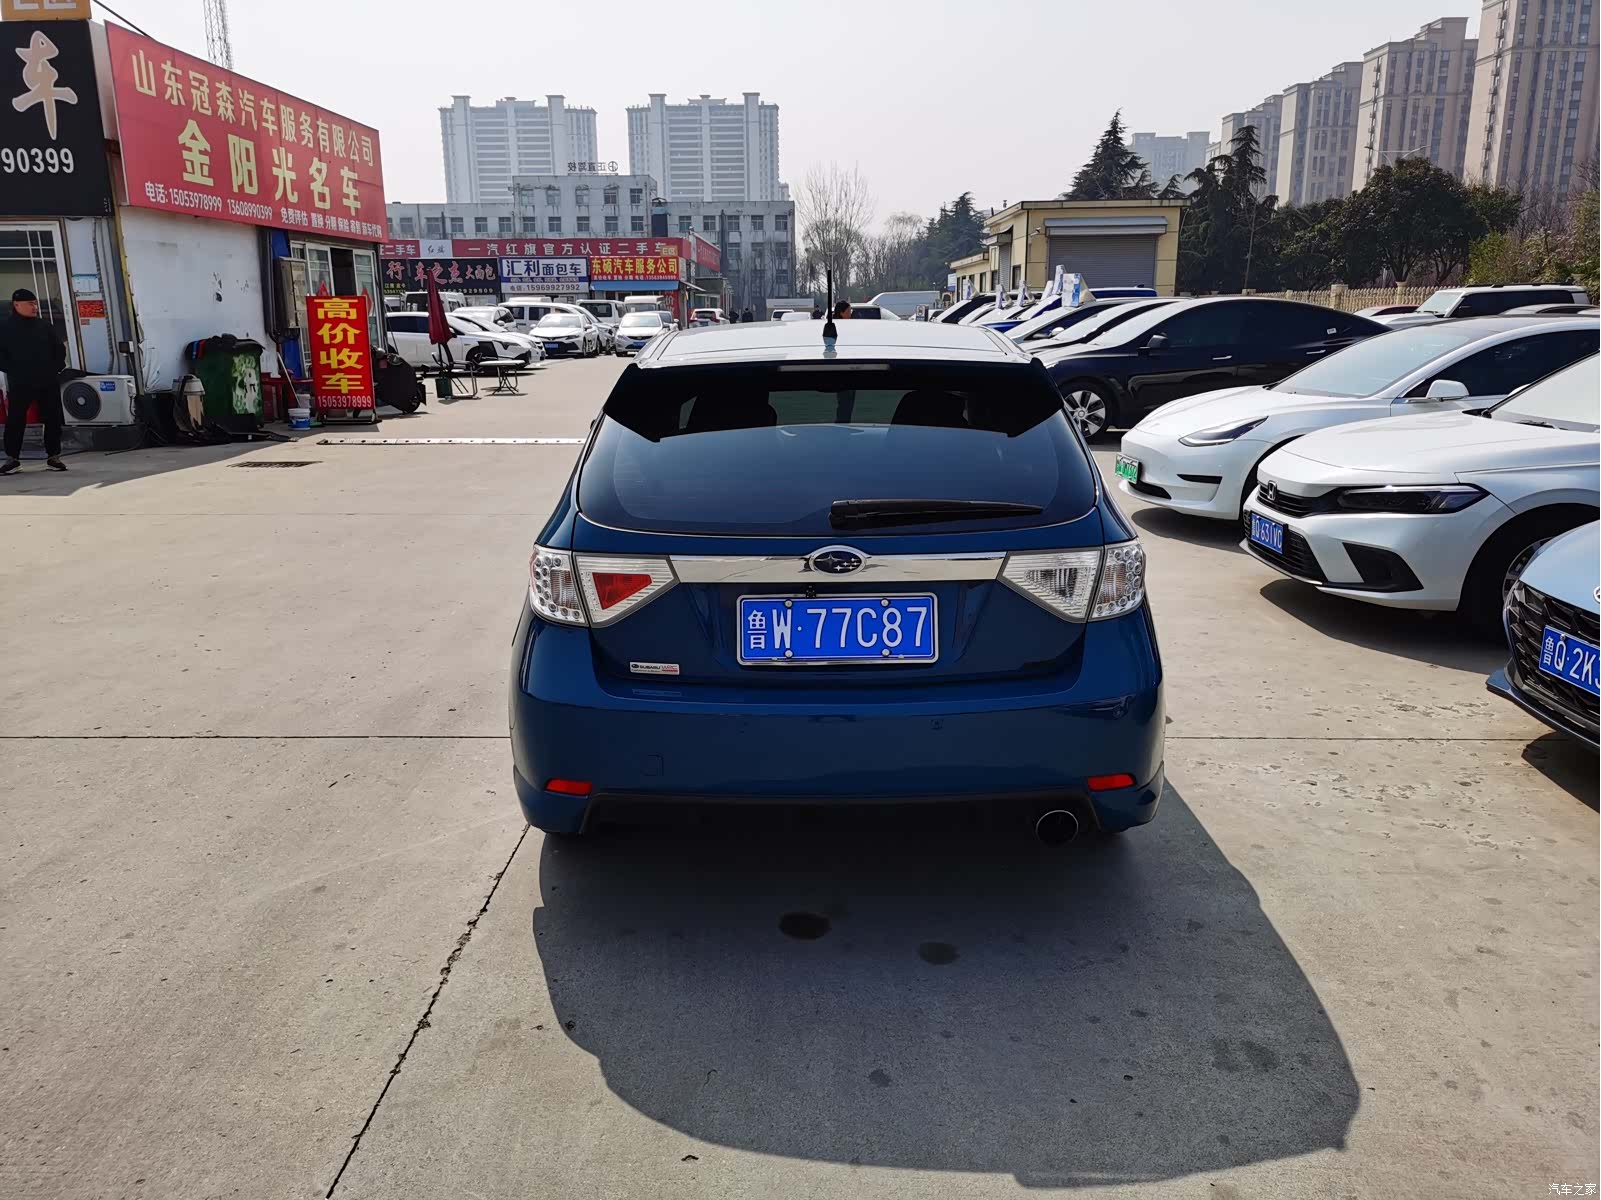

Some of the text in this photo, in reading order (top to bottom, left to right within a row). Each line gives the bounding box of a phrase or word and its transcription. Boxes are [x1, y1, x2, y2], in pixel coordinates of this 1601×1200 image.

[12, 30, 78, 140] 车
[131, 49, 374, 167] 山东冠森汽车服务有限公司
[1, 147, 75, 174] 90399
[178, 119, 362, 216] 金阳光名车
[227, 199, 273, 220] 13608990399
[505, 259, 582, 276] 汇利面包车
[591, 258, 678, 275] 东硕汽车服务公司
[314, 297, 364, 394] 高价收车
[318, 395, 372, 408] 15053978999
[747, 607, 928, 649] 鲁W·77C87
[1543, 636, 1600, 689] 鲁Q·2K
